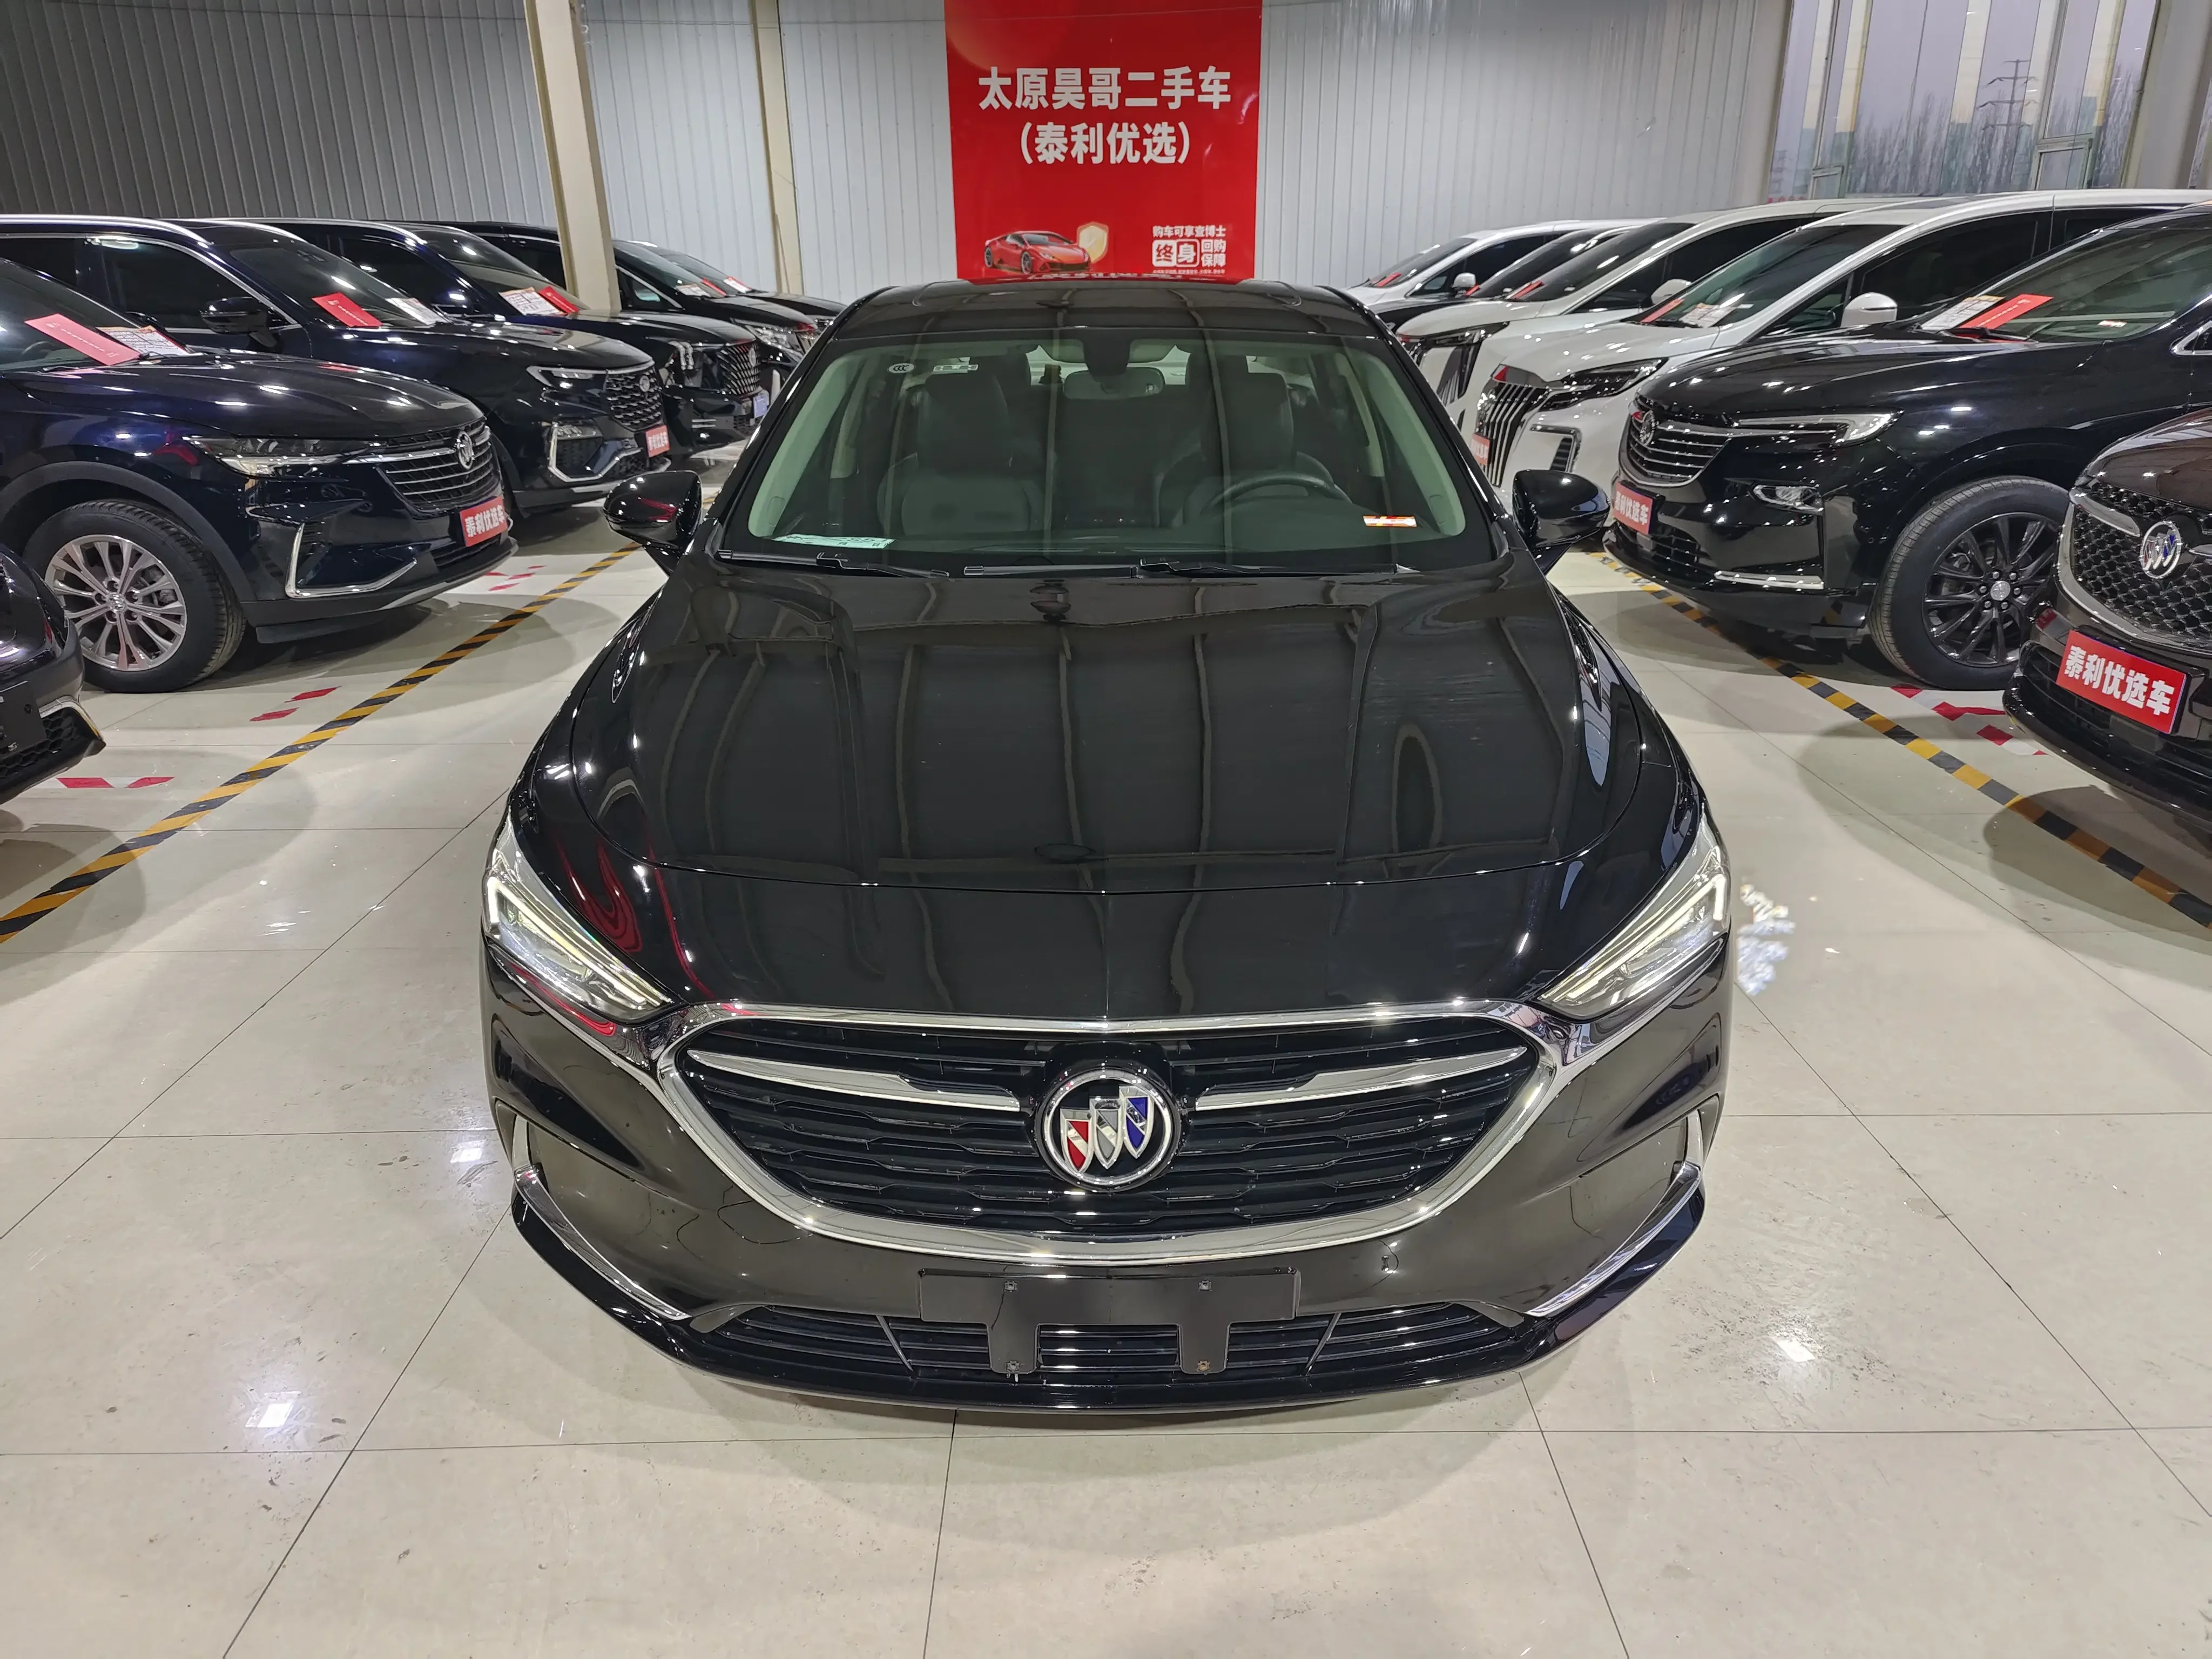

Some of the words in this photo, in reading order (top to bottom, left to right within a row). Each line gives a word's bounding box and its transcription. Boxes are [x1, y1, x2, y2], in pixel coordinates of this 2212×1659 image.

[978, 65, 1231, 110] 太原昊哥二手车
[1021, 122, 1190, 164] (泰利优选)
[1156, 243, 1196, 263] 终身
[465, 505, 505, 537] 泰利优选车
[2064, 645, 2175, 716] 泰利优选车
